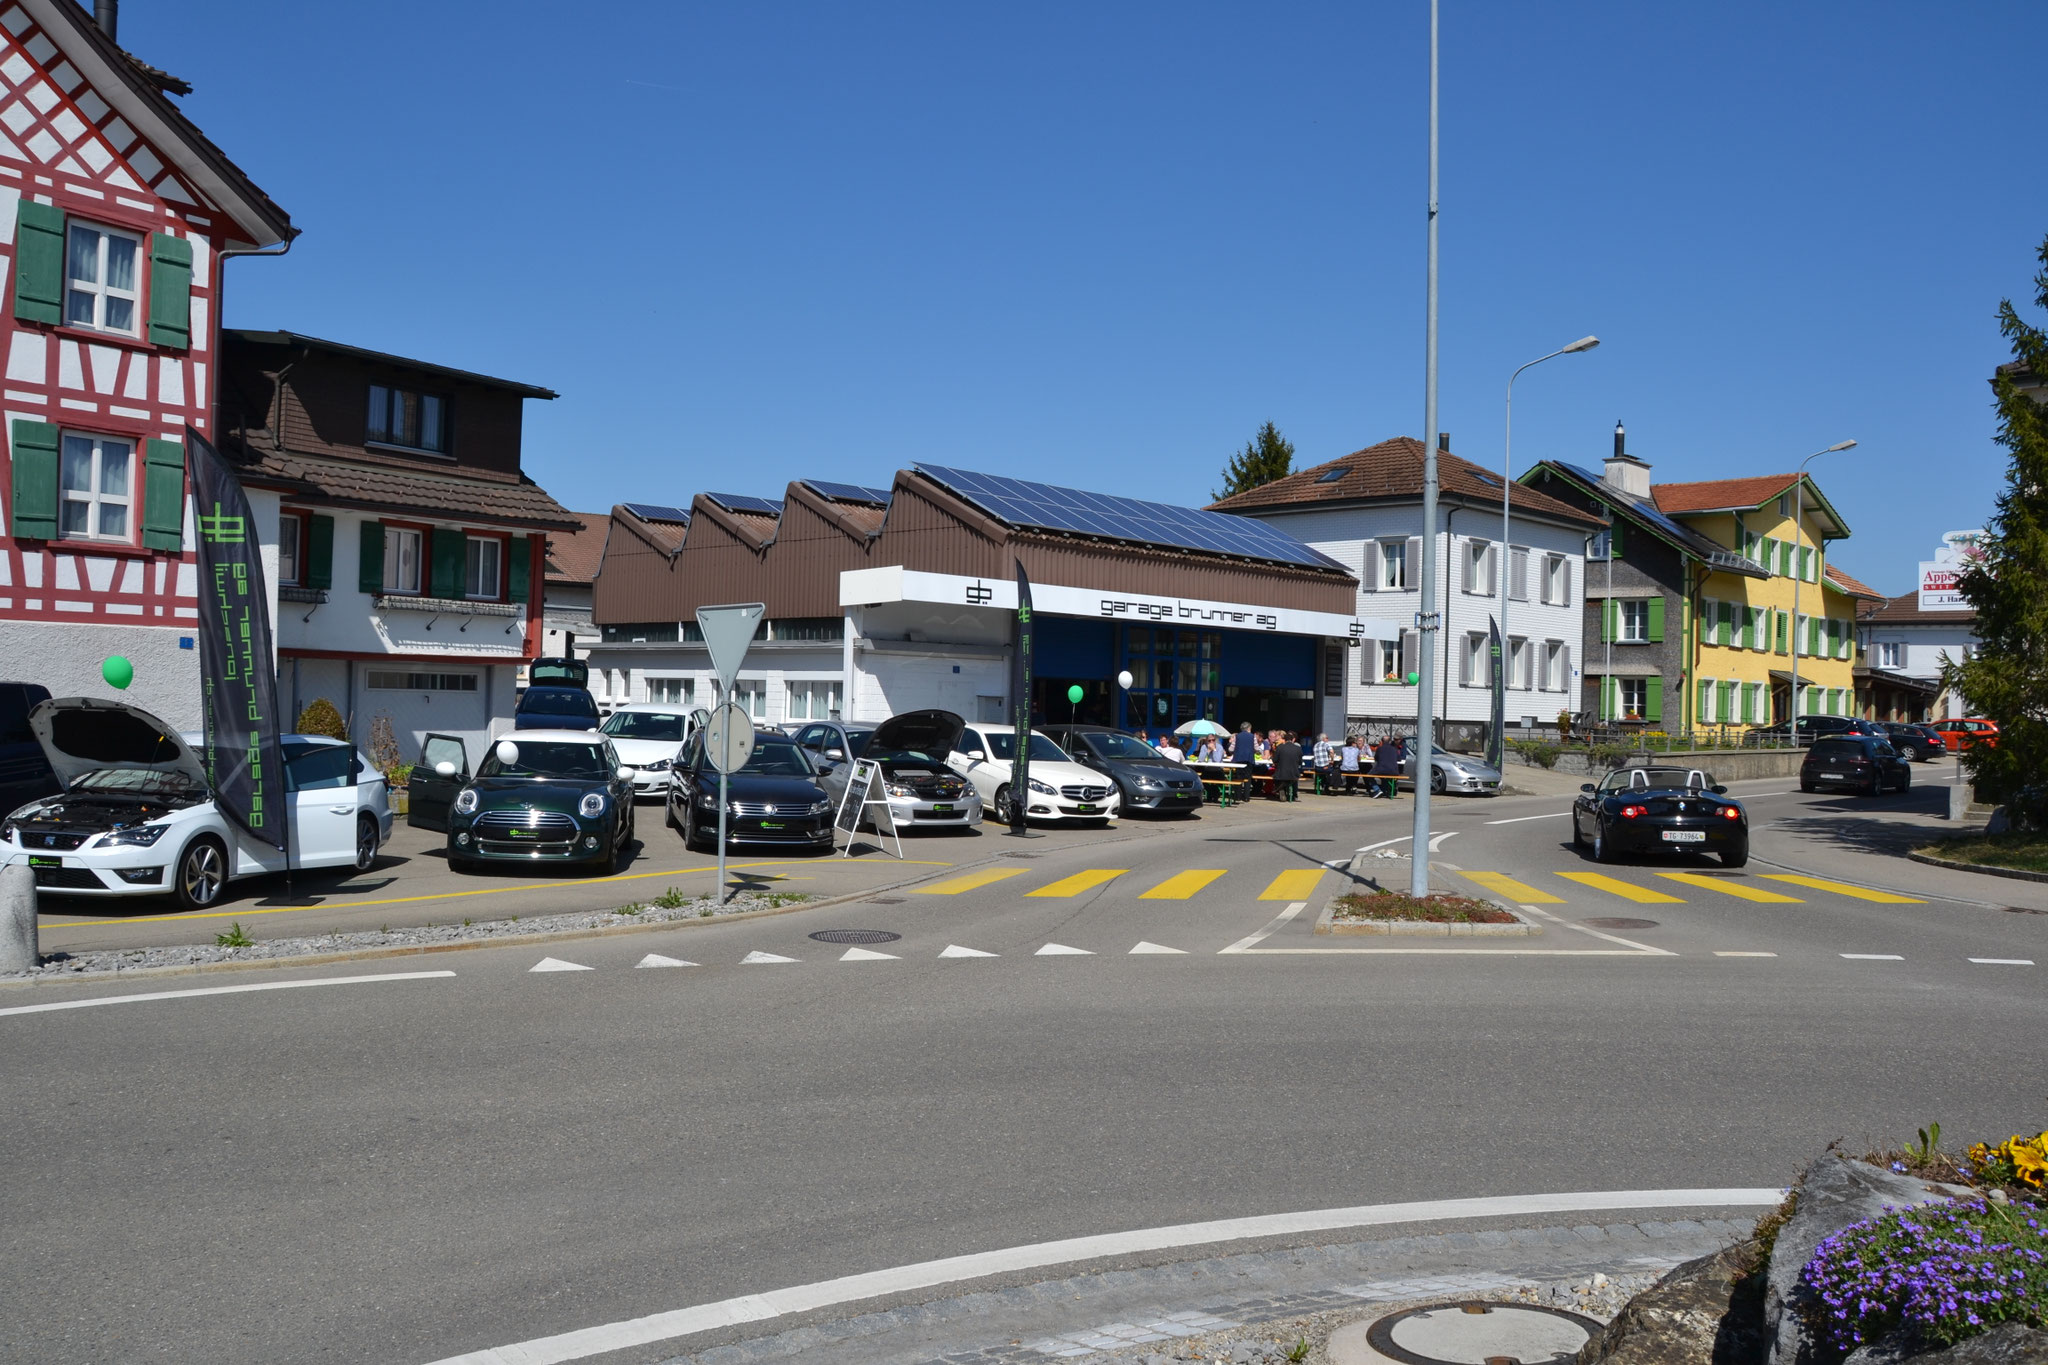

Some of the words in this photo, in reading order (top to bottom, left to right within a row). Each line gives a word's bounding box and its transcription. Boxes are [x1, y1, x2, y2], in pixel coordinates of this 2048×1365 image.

[1101, 600, 1173, 620] garage
[1178, 600, 1253, 623] brunner
[1256, 614, 1276, 629] ag
[1669, 832, 1677, 840] TG
